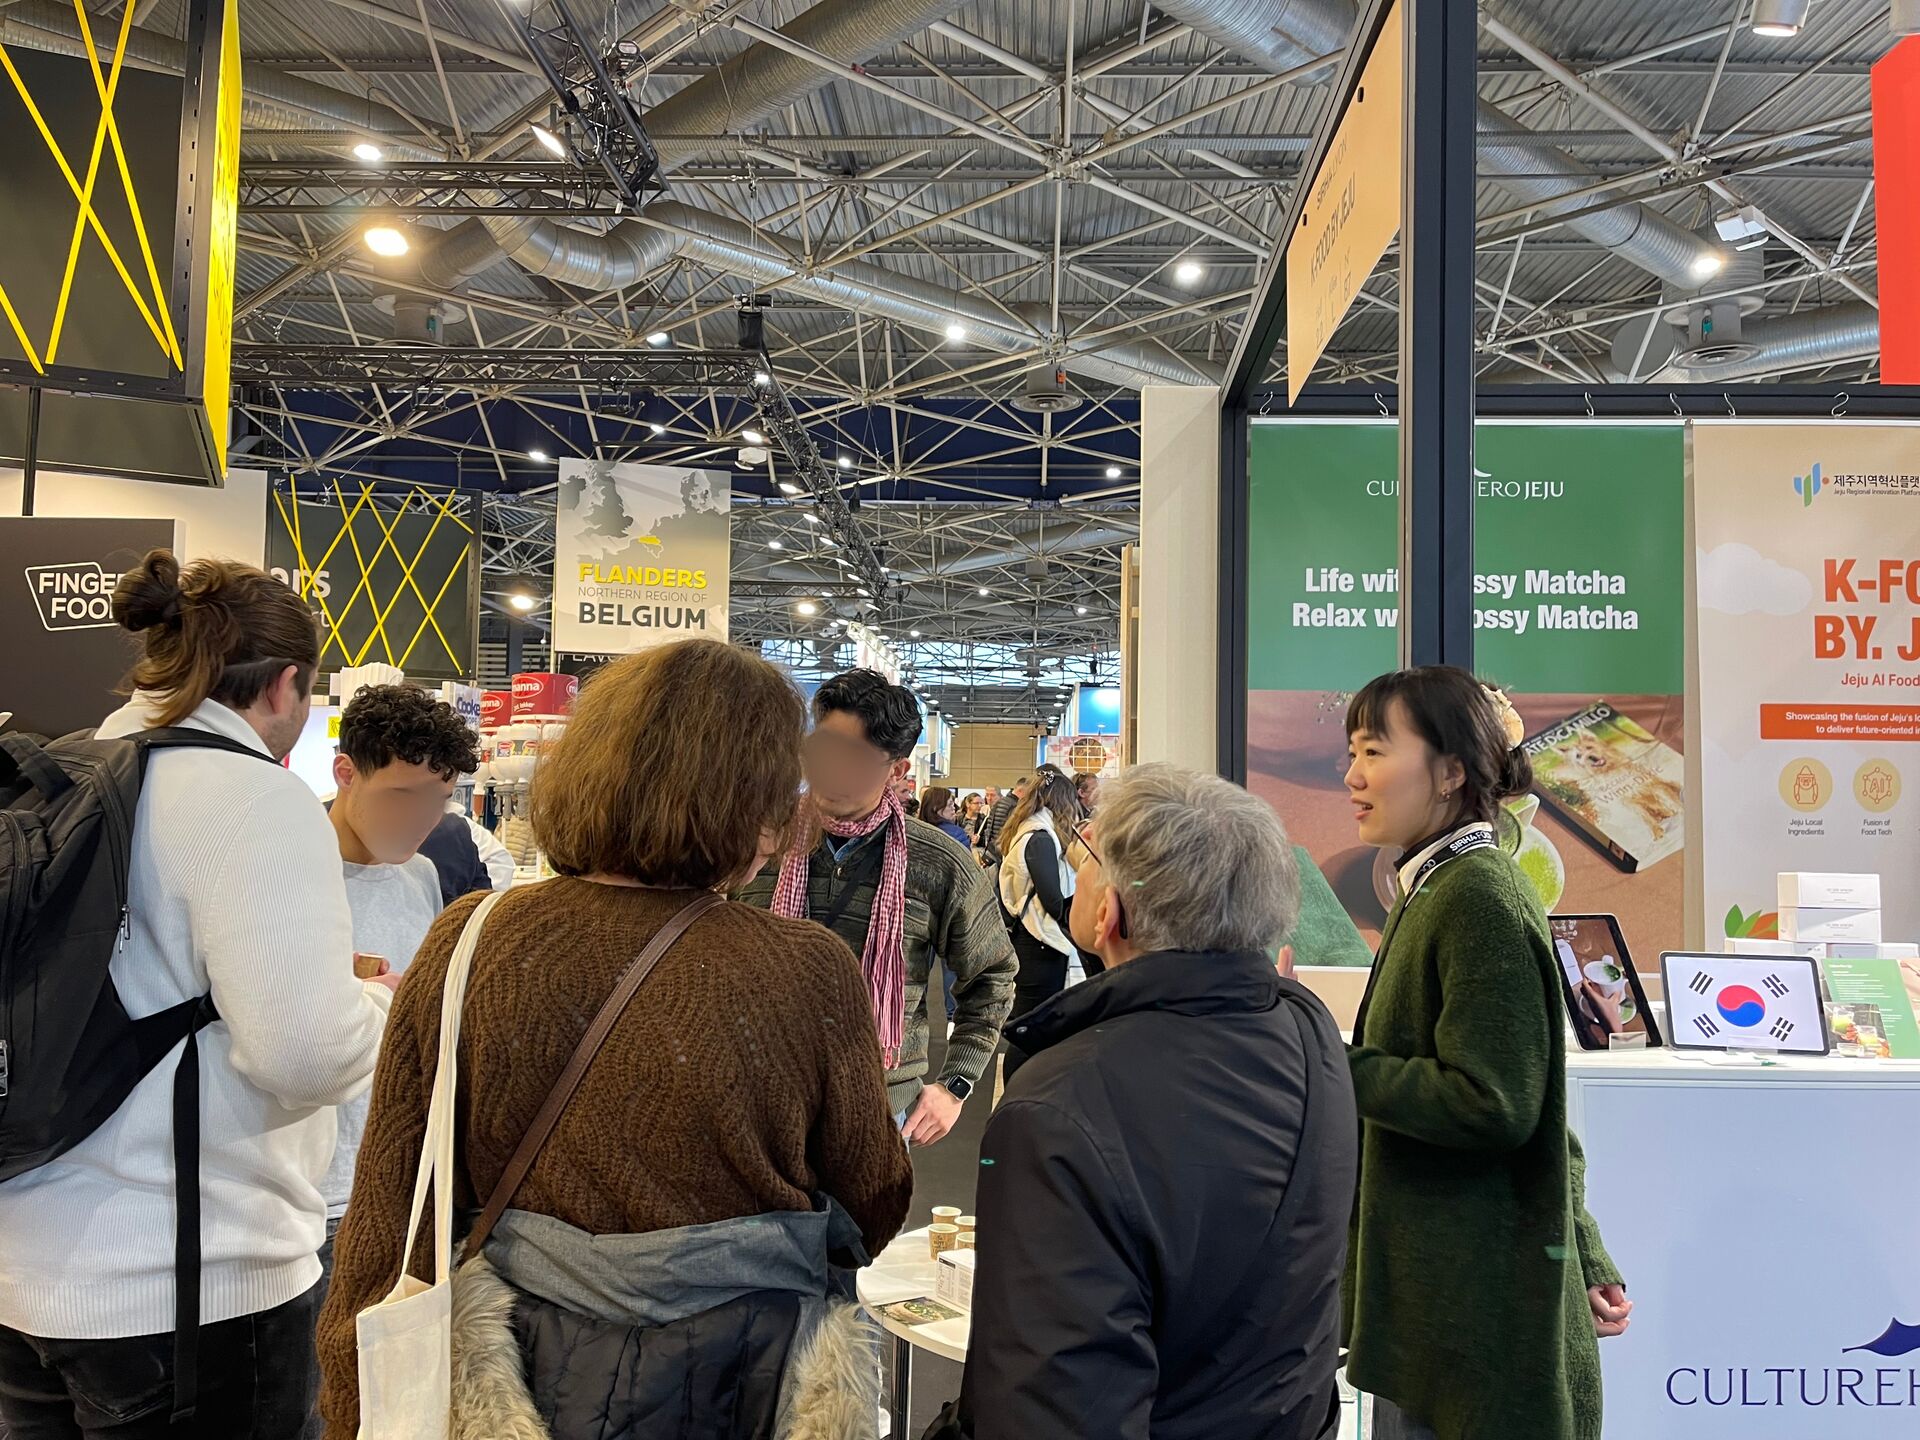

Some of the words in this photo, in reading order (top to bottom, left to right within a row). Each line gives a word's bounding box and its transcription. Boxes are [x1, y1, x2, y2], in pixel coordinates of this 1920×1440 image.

[1524, 481, 1565, 500] JEJU
[578, 562, 708, 590] FLANDERS
[1305, 567, 1354, 593] Life
[1362, 568, 1399, 593] wit
[1474, 573, 1517, 599] ssy
[1524, 569, 1626, 595] Matcha
[578, 586, 641, 600] NORTHERN
[645, 590, 688, 602] REGION
[691, 593, 708, 604] OF
[51, 597, 114, 620] FOO
[578, 601, 706, 630] BELGIUM
[1292, 602, 1367, 628] Relax
[1474, 609, 1530, 635] ossy
[1537, 604, 1639, 631] Matcha
[1814, 615, 1883, 660] BY.
[1841, 672, 1869, 688] Jeju
[1888, 673, 1920, 687] Food
[1785, 711, 1838, 722] Showcasing
[1840, 712, 1854, 721] the
[1855, 712, 1879, 721] fusion
[1880, 712, 1889, 721] of
[1890, 713, 1913, 723] Jeju's
[1816, 725, 1825, 734] to
[1827, 725, 1854, 734] deliver
[1855, 725, 1914, 735] future-oriented
[1789, 818, 1804, 828] Jeju
[1805, 818, 1823, 826] Local
[1863, 818, 1883, 826] Fusion
[1884, 818, 1891, 826] of
[1787, 828, 1825, 837] Ingredients
[1861, 828, 1877, 836] Food
[1878, 828, 1892, 836] Tech
